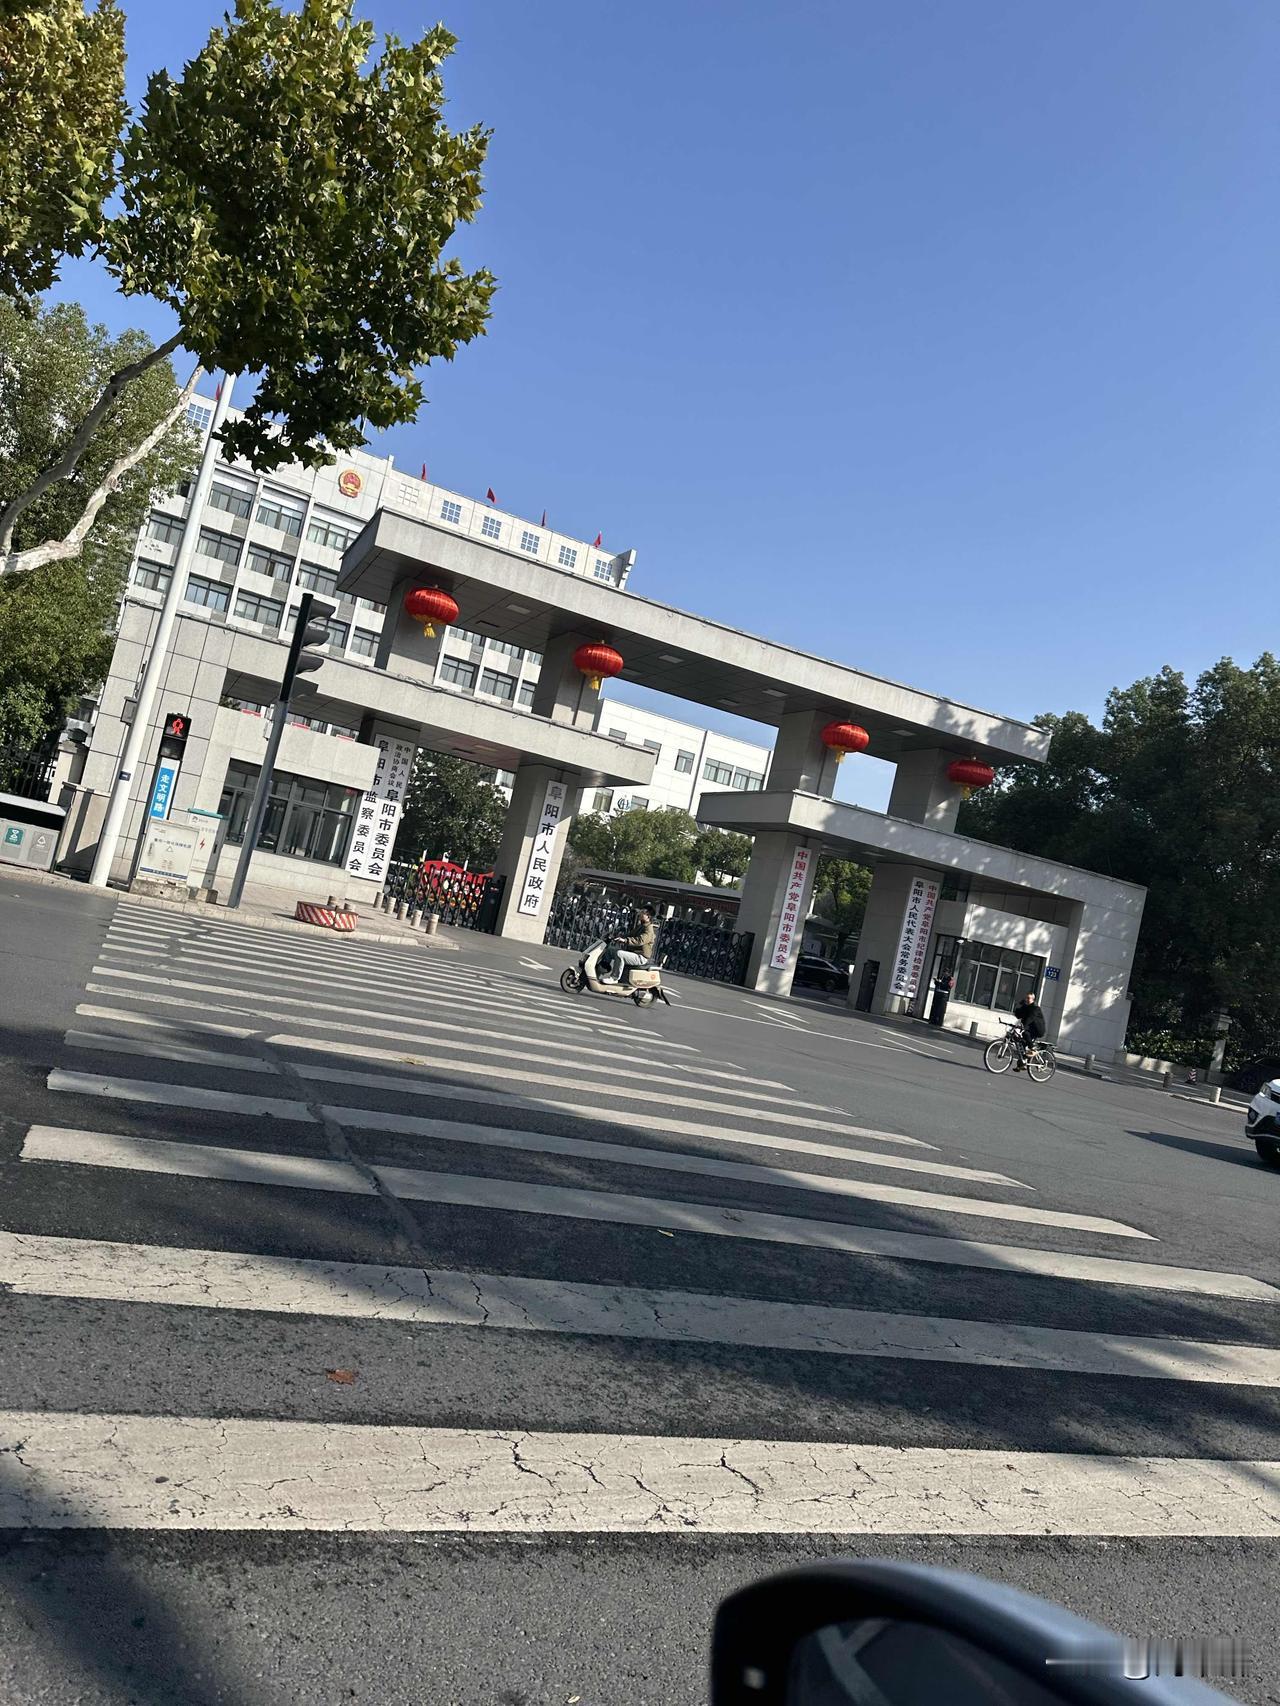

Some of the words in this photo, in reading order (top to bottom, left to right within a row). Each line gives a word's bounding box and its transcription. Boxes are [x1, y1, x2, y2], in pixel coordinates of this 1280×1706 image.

[153, 774, 169, 812] 走文明路
[396, 745, 411, 789] 中国人民
[368, 789, 399, 876] 阜阳市委员会
[524, 786, 562, 908] 阜阳市人民政府
[776, 851, 807, 963] 中国共产党阜阳市委员会
[894, 881, 923, 989] 阜阳市人民代表大会常务委员会
